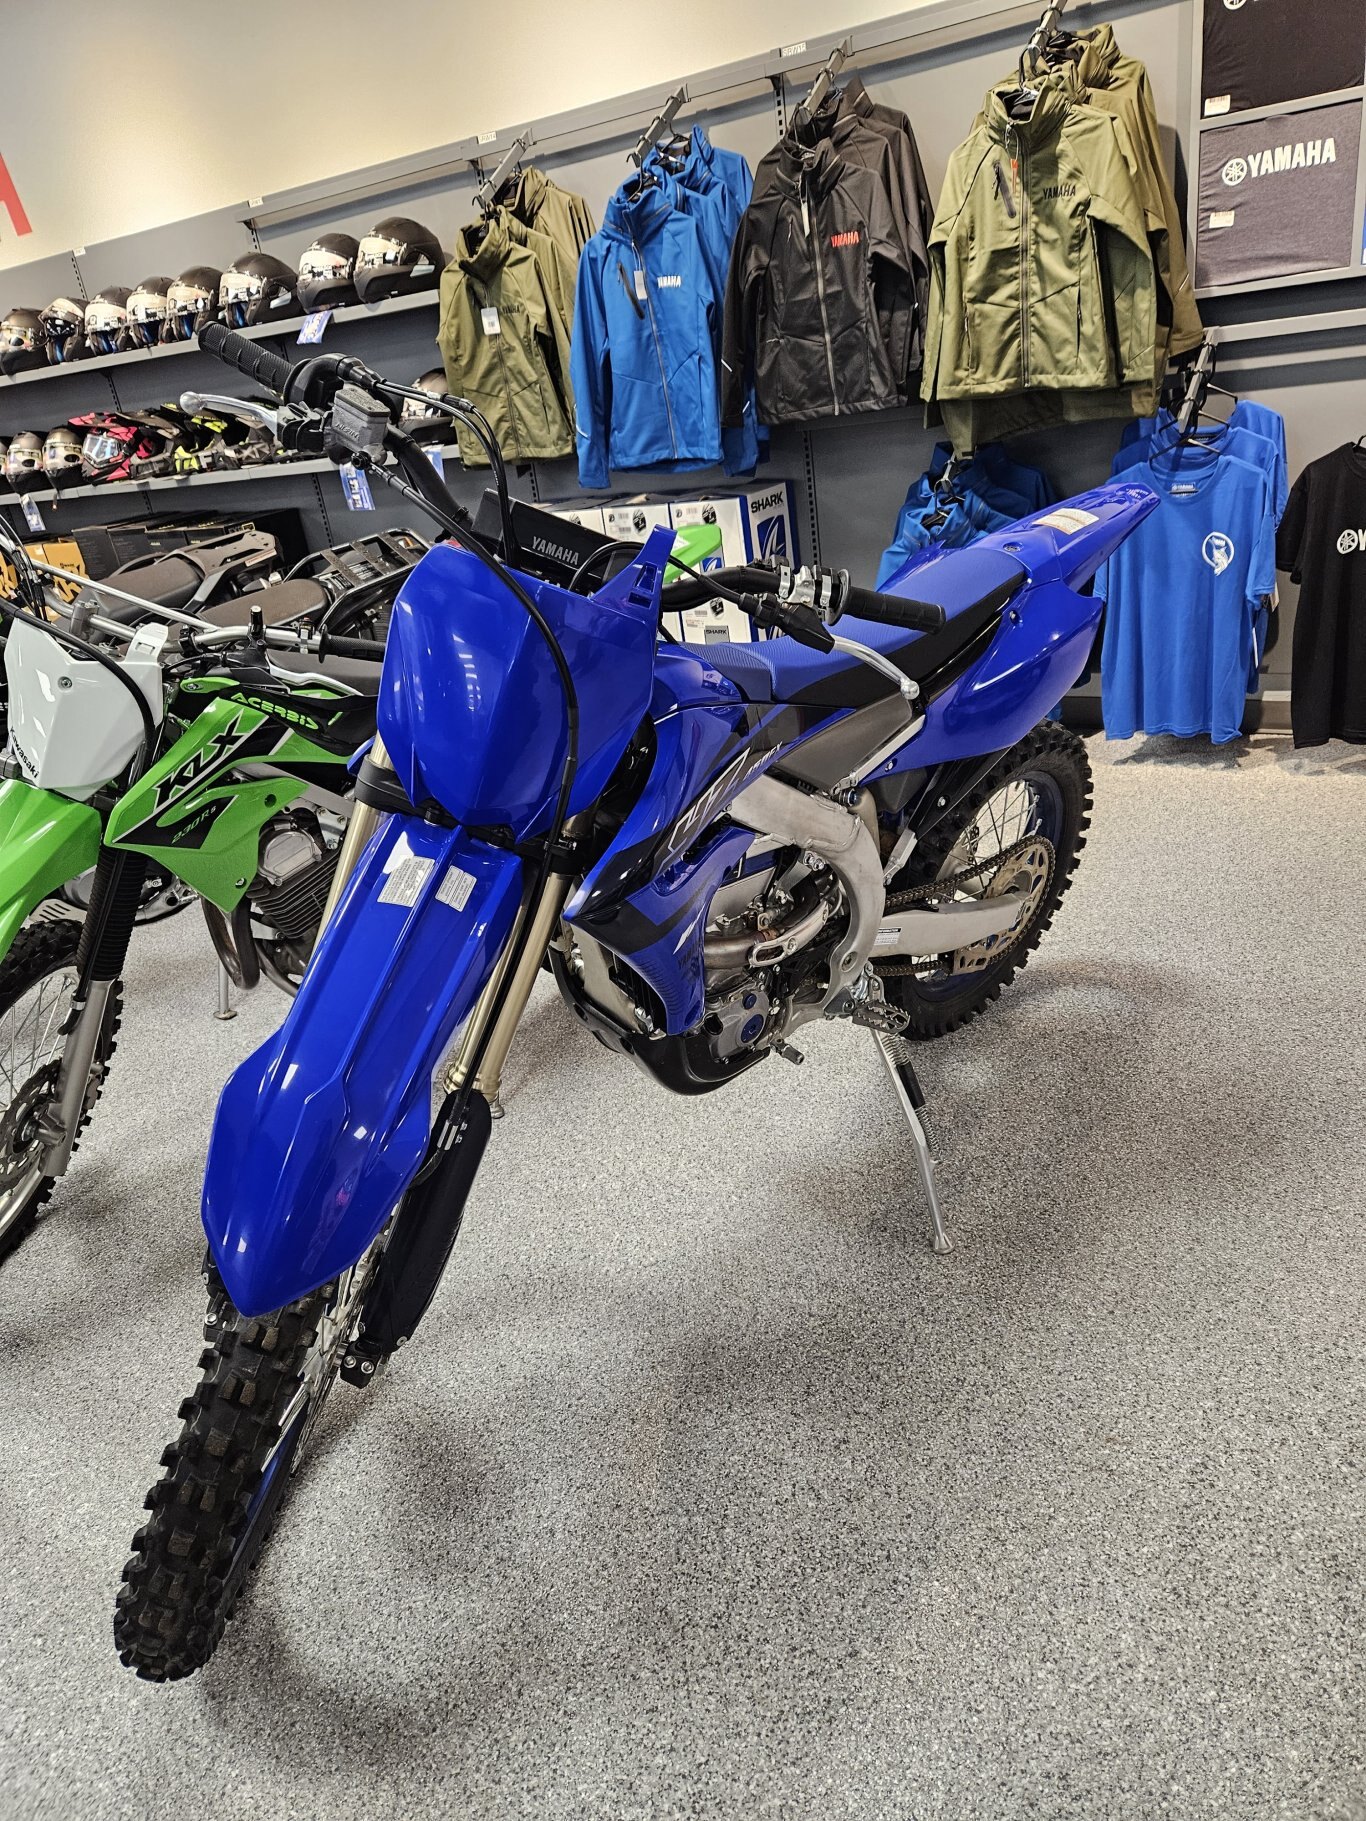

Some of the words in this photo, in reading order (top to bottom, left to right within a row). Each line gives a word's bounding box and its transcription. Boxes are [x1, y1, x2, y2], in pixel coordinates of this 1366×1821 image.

[1247, 137, 1336, 178] YAMAHA
[1043, 183, 1076, 200] YAMAHA
[831, 231, 860, 248] YAMAHA
[750, 491, 784, 514] SHARK
[531, 535, 579, 566] YAMAHA
[231, 692, 319, 730] ACERBIS
[10, 726, 40, 778] Kawasaki
[152, 708, 250, 815] KLX
